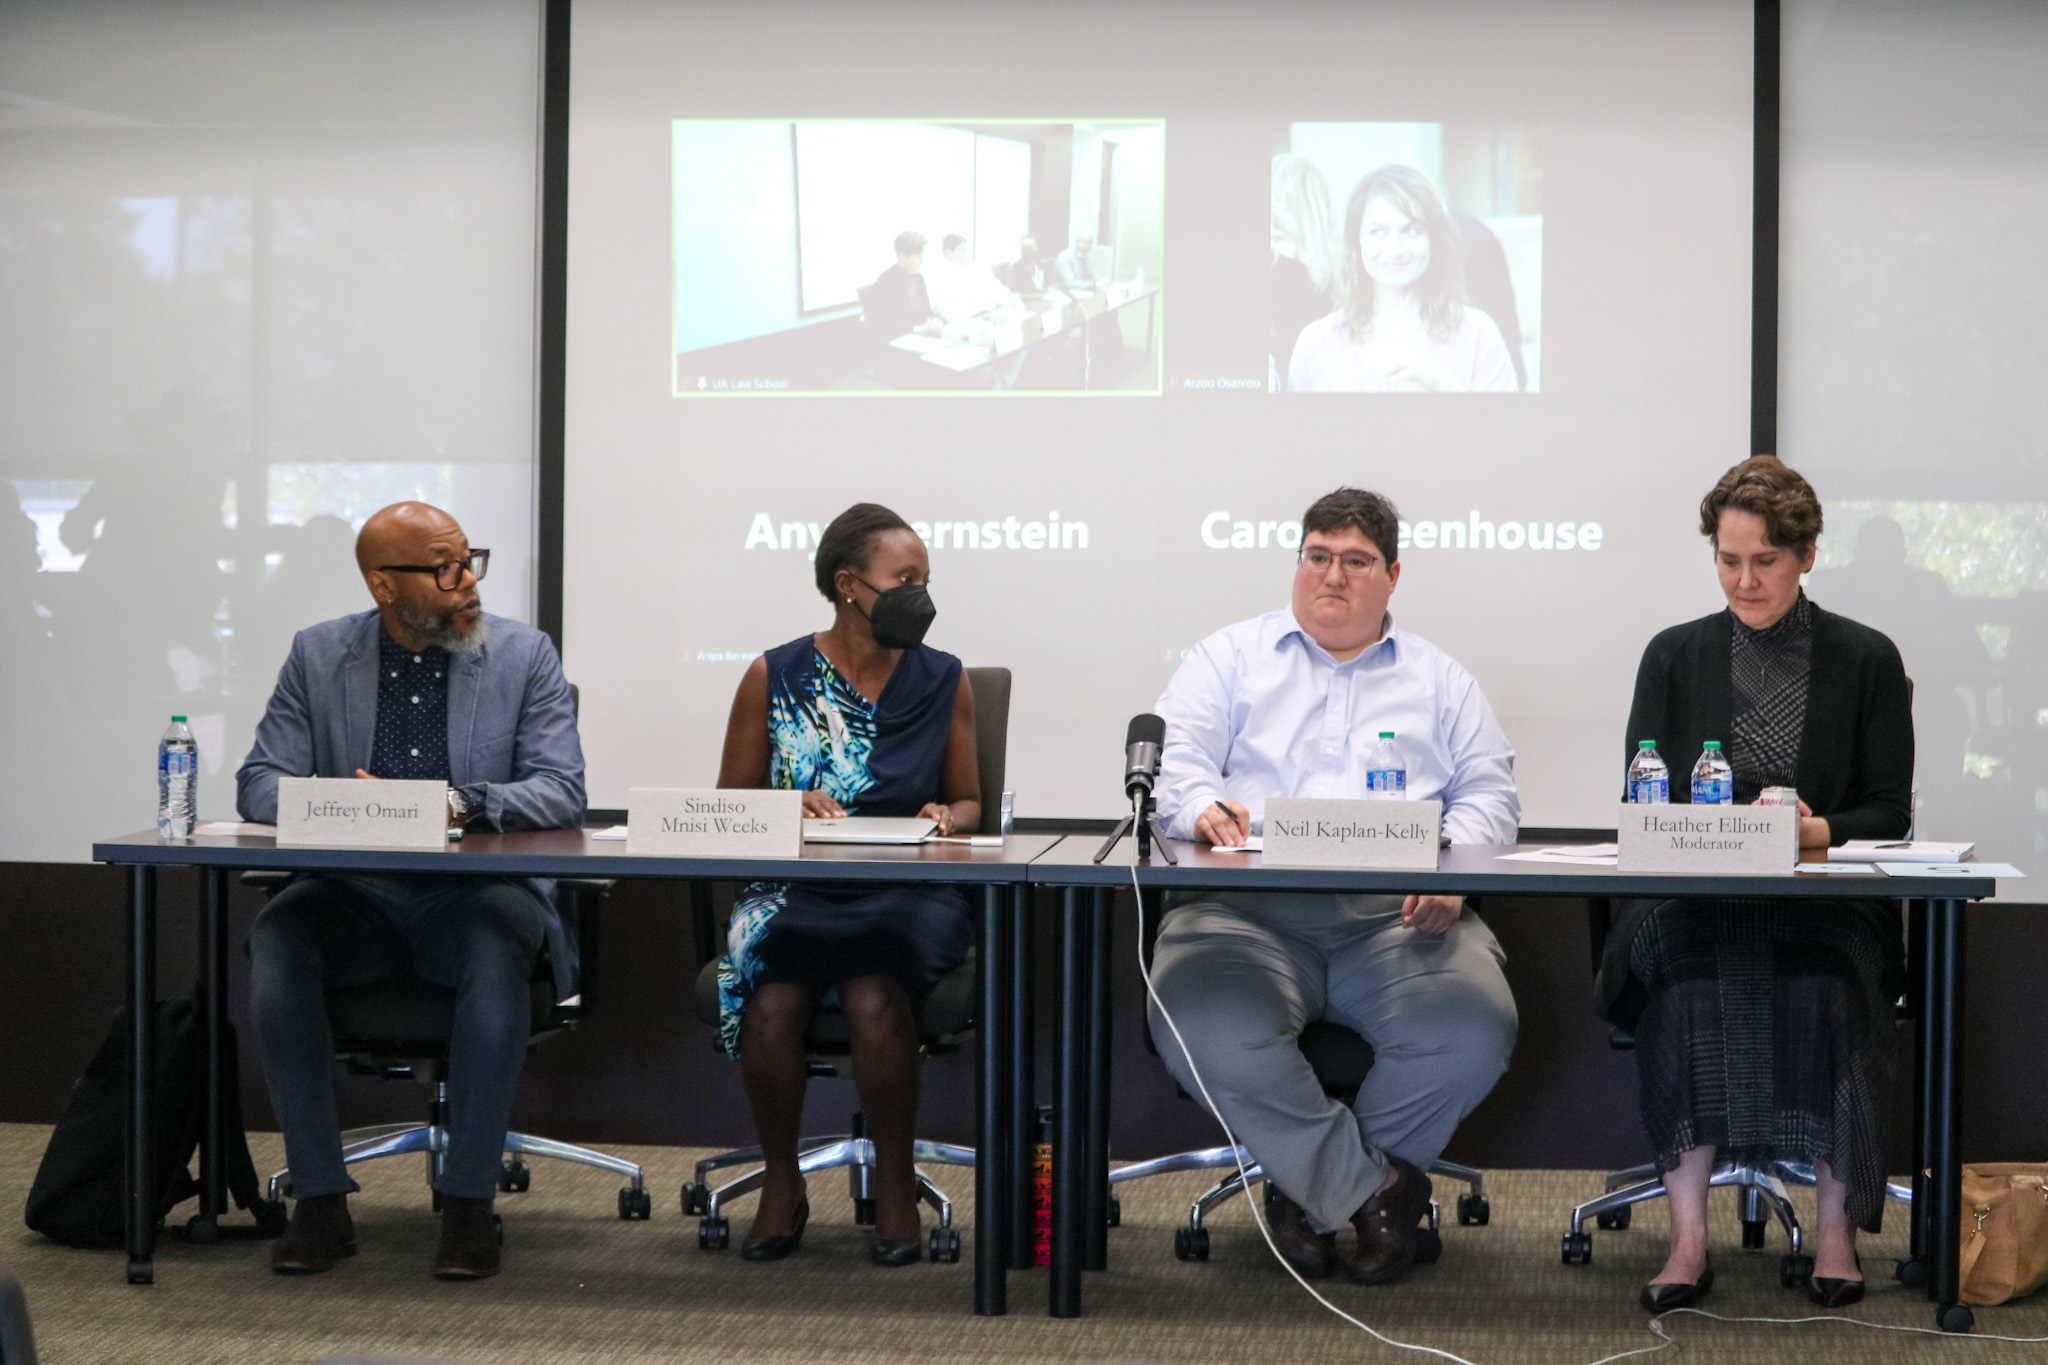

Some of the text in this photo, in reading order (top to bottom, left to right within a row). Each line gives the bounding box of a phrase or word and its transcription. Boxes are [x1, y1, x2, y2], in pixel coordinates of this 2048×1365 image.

[713, 377, 789, 390] UA Law School
[1183, 378, 1215, 389] Arzoo
[744, 510, 1089, 561] Any ernstein
[1201, 510, 1604, 551] Caro eenhouse
[696, 651, 723, 663] Anya
[304, 801, 418, 822] Jeffrey Omari
[684, 798, 746, 814] Sindiso
[661, 817, 768, 834] Mnisi Weeks
[1274, 820, 1429, 844] Neil Kaplan-Kelly
[1643, 816, 1772, 834] Heather Elliott
[1670, 836, 1744, 850] Moderator
